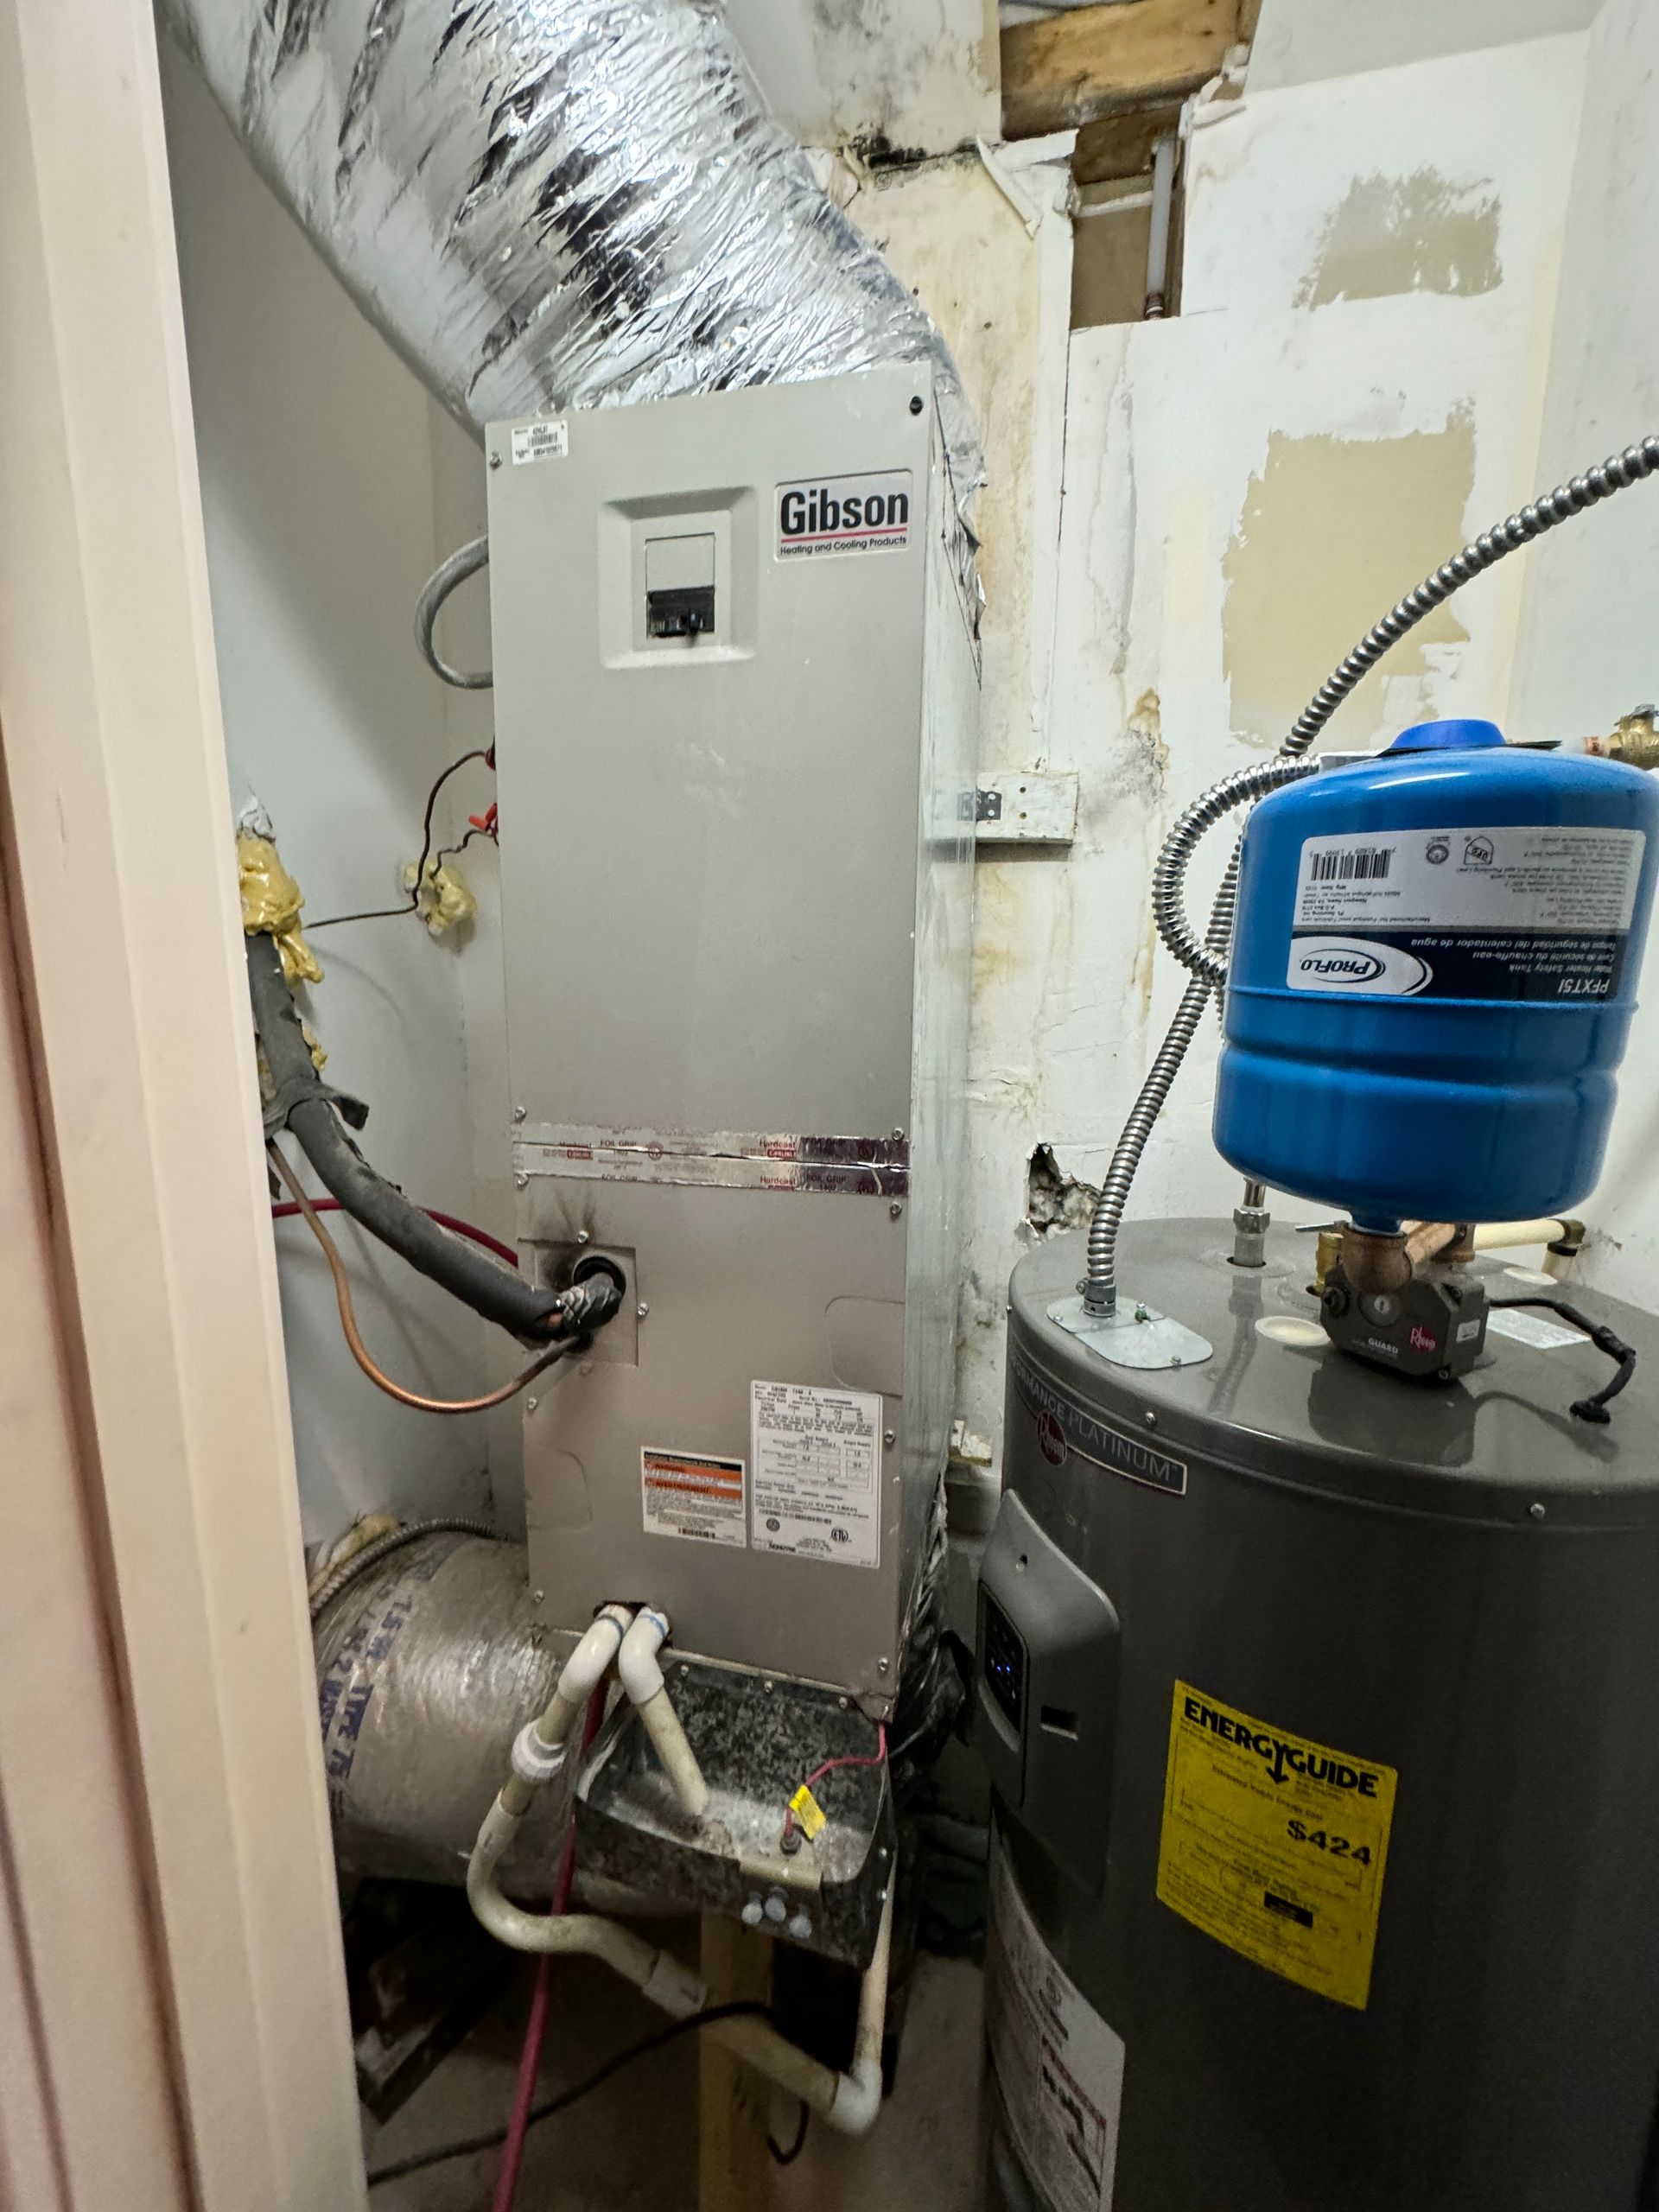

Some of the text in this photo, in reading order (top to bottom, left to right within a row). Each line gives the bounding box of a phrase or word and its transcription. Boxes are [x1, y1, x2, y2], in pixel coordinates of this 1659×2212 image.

[780, 488, 908, 535] Gibson
[780, 537, 907, 555] Heating and Cooling Products
[1411, 937, 1437, 947] agua
[1440, 938, 1454, 948] de
[1456, 938, 1513, 949] calentador
[1515, 940, 1530, 950] del
[1533, 939, 1579, 950] seguridad
[1472, 950, 1535, 961] chauffe-eau
[1536, 951, 1548, 960] du
[1508, 963, 1532, 973] Tank
[1534, 963, 1564, 974] Safety
[759, 1138, 798, 1149] Hardcast
[759, 1174, 798, 1185] Hardcast
[826, 1175, 848, 1185] GRIP
[1368, 1337, 1399, 1356] GUARD
[1067, 1410, 1172, 1482] PLATINUM
[1184, 1695, 1379, 1799] ENERGYGUIDE
[1287, 1818, 1371, 1866] $424
